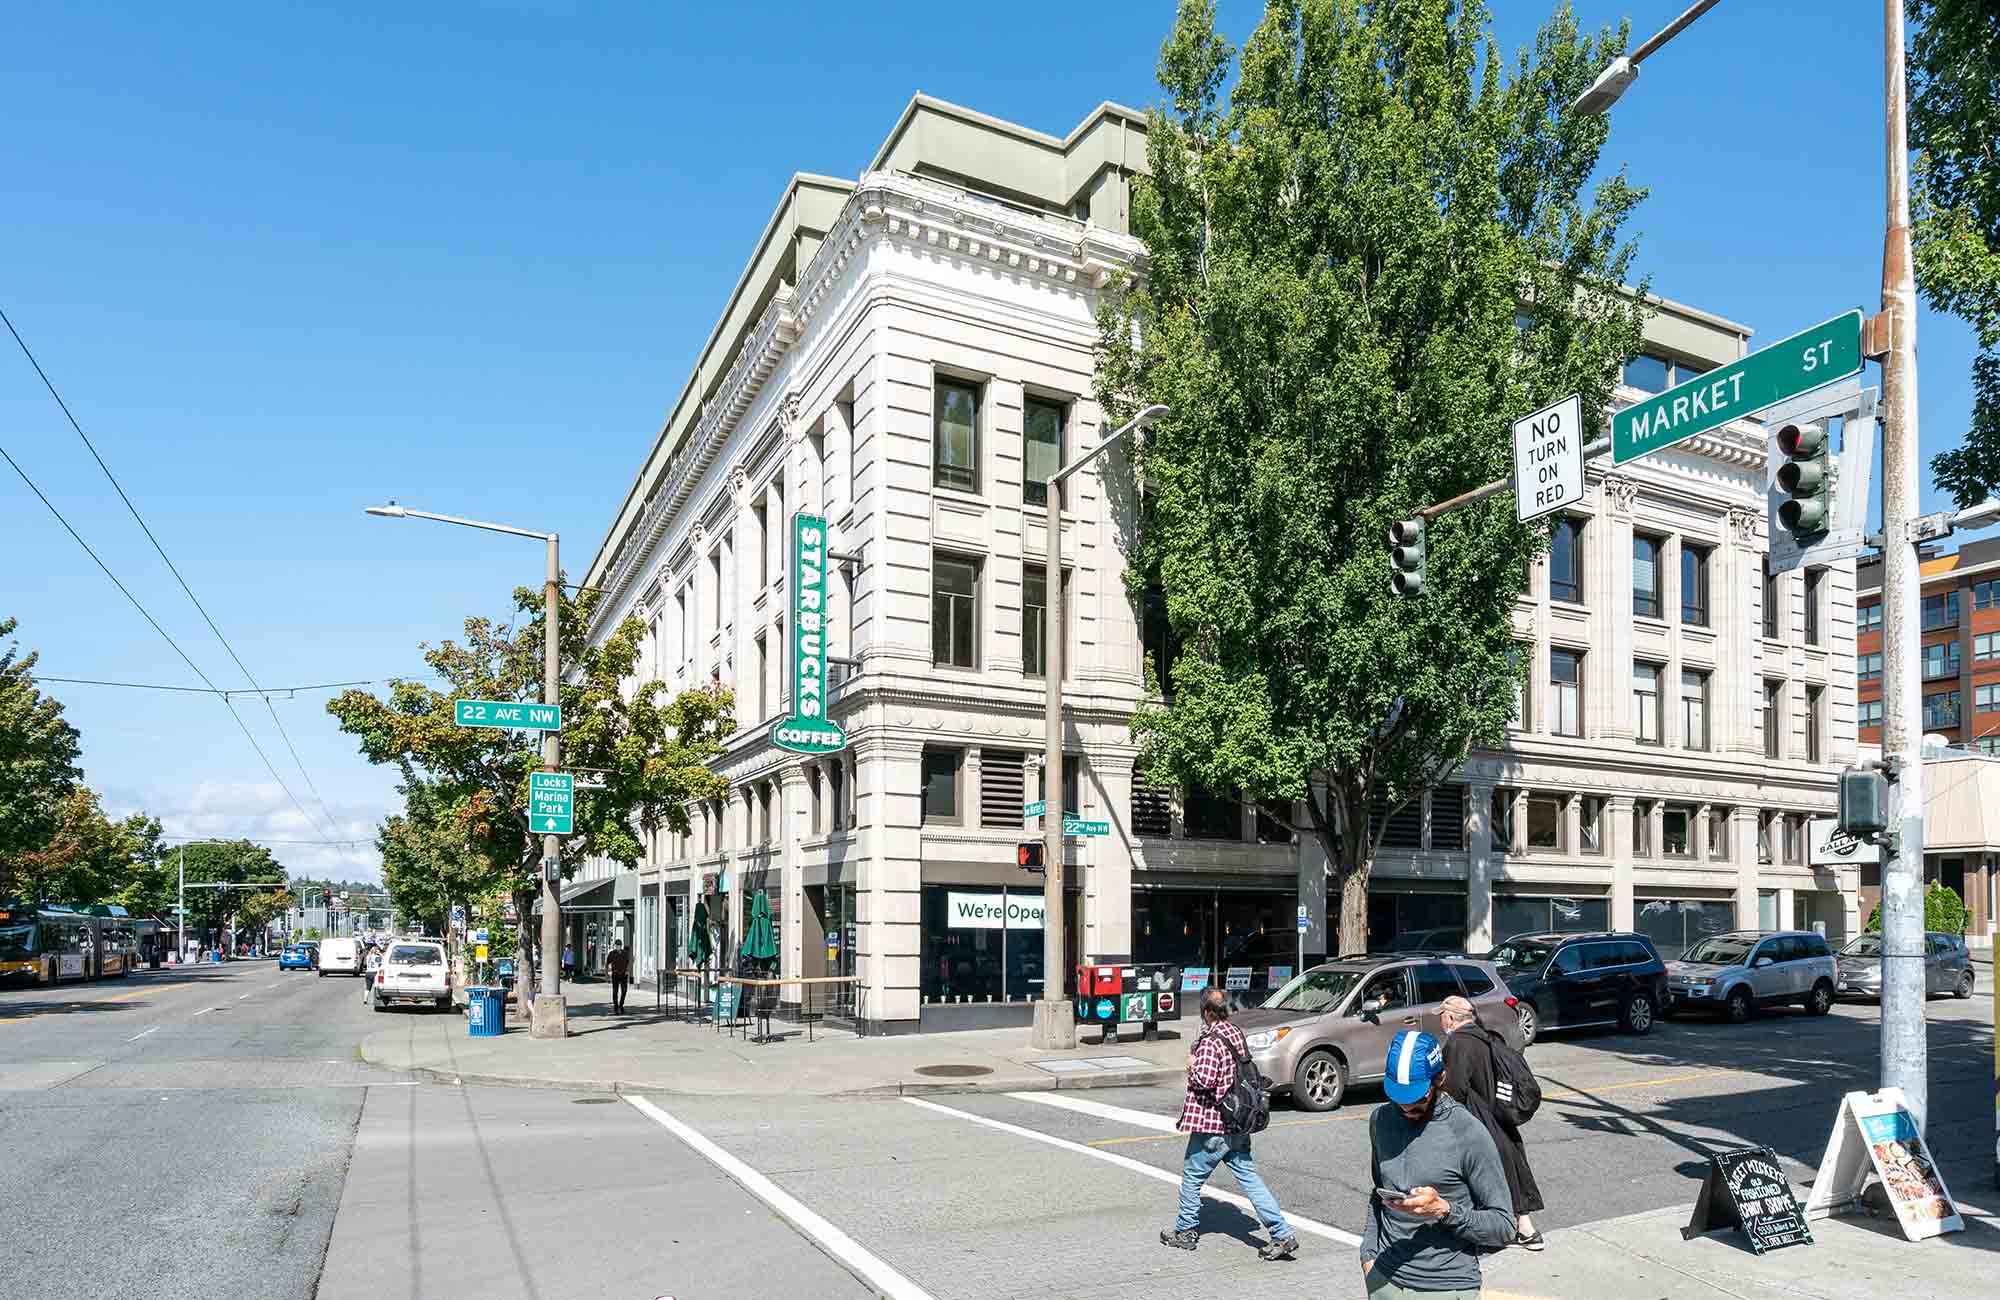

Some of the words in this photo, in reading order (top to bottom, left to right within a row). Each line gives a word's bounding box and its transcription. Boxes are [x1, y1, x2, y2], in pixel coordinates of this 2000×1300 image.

[1631, 371, 1745, 444] MARKET
[1802, 339, 1833, 372] ST
[1532, 412, 1560, 443] NO
[1528, 436, 1567, 466] TURN
[1538, 462, 1559, 484] ON
[1536, 484, 1565, 508] RED
[800, 527, 822, 718] STARBUCKS
[463, 706, 486, 719] 22
[495, 708, 521, 721] AVE
[530, 711, 554, 723] NW
[777, 728, 841, 747] COFFEE
[537, 775, 567, 788] Locks
[534, 791, 569, 803] Marina
[539, 803, 564, 814] Park
[1097, 824, 1108, 833] NW
[1819, 835, 1857, 853] BALLA
[1740, 1183, 1781, 1201] FASHIONED
